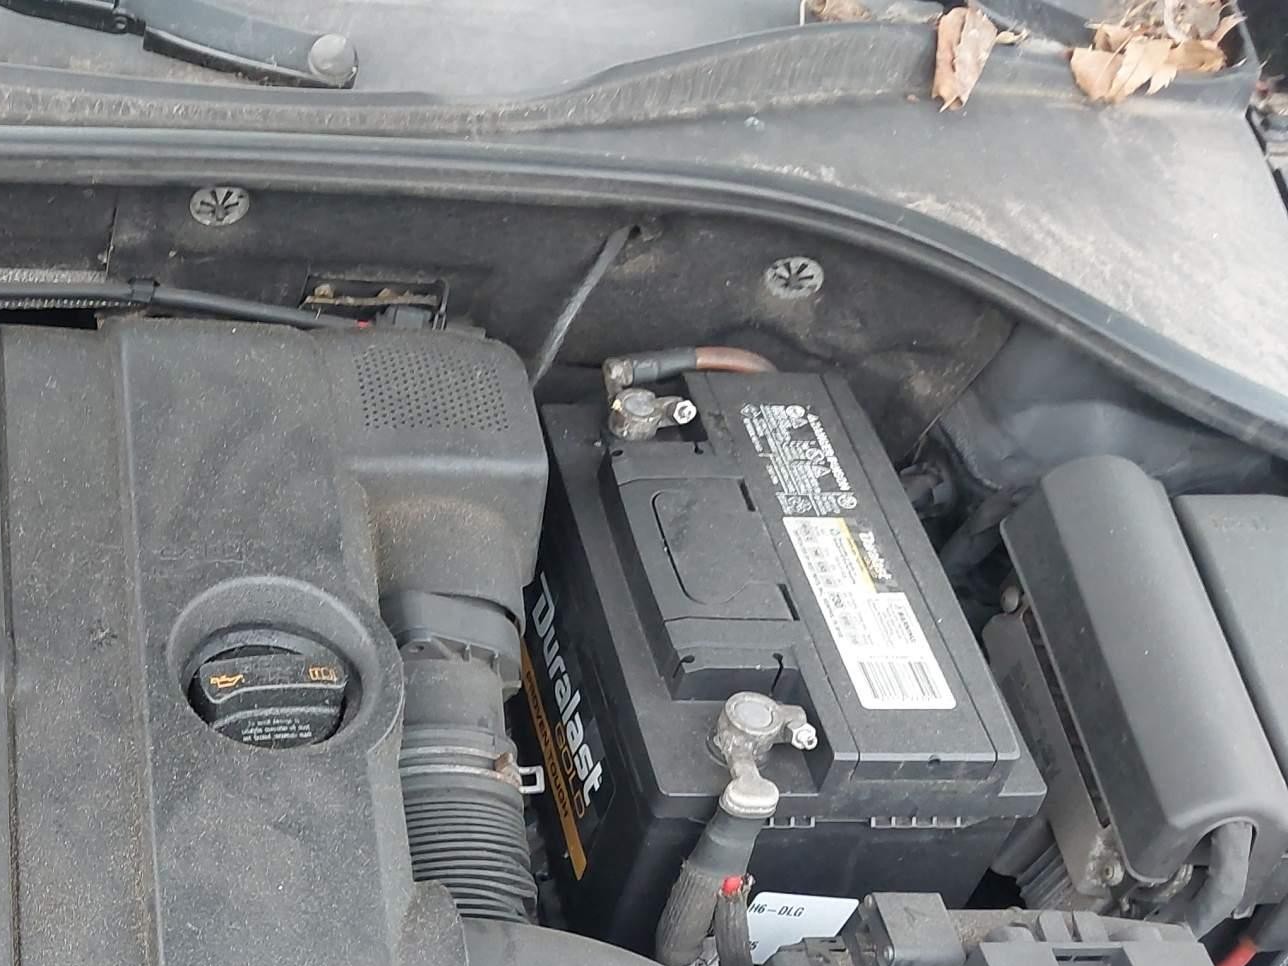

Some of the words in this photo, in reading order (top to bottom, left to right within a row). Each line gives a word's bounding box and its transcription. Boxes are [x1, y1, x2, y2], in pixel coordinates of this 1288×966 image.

[525, 670, 550, 747] PROVEN
[546, 752, 569, 818] TOUGH
[532, 571, 603, 807] Duralast
[554, 720, 587, 819] GOLD
[749, 903, 805, 918] H6-DLG
